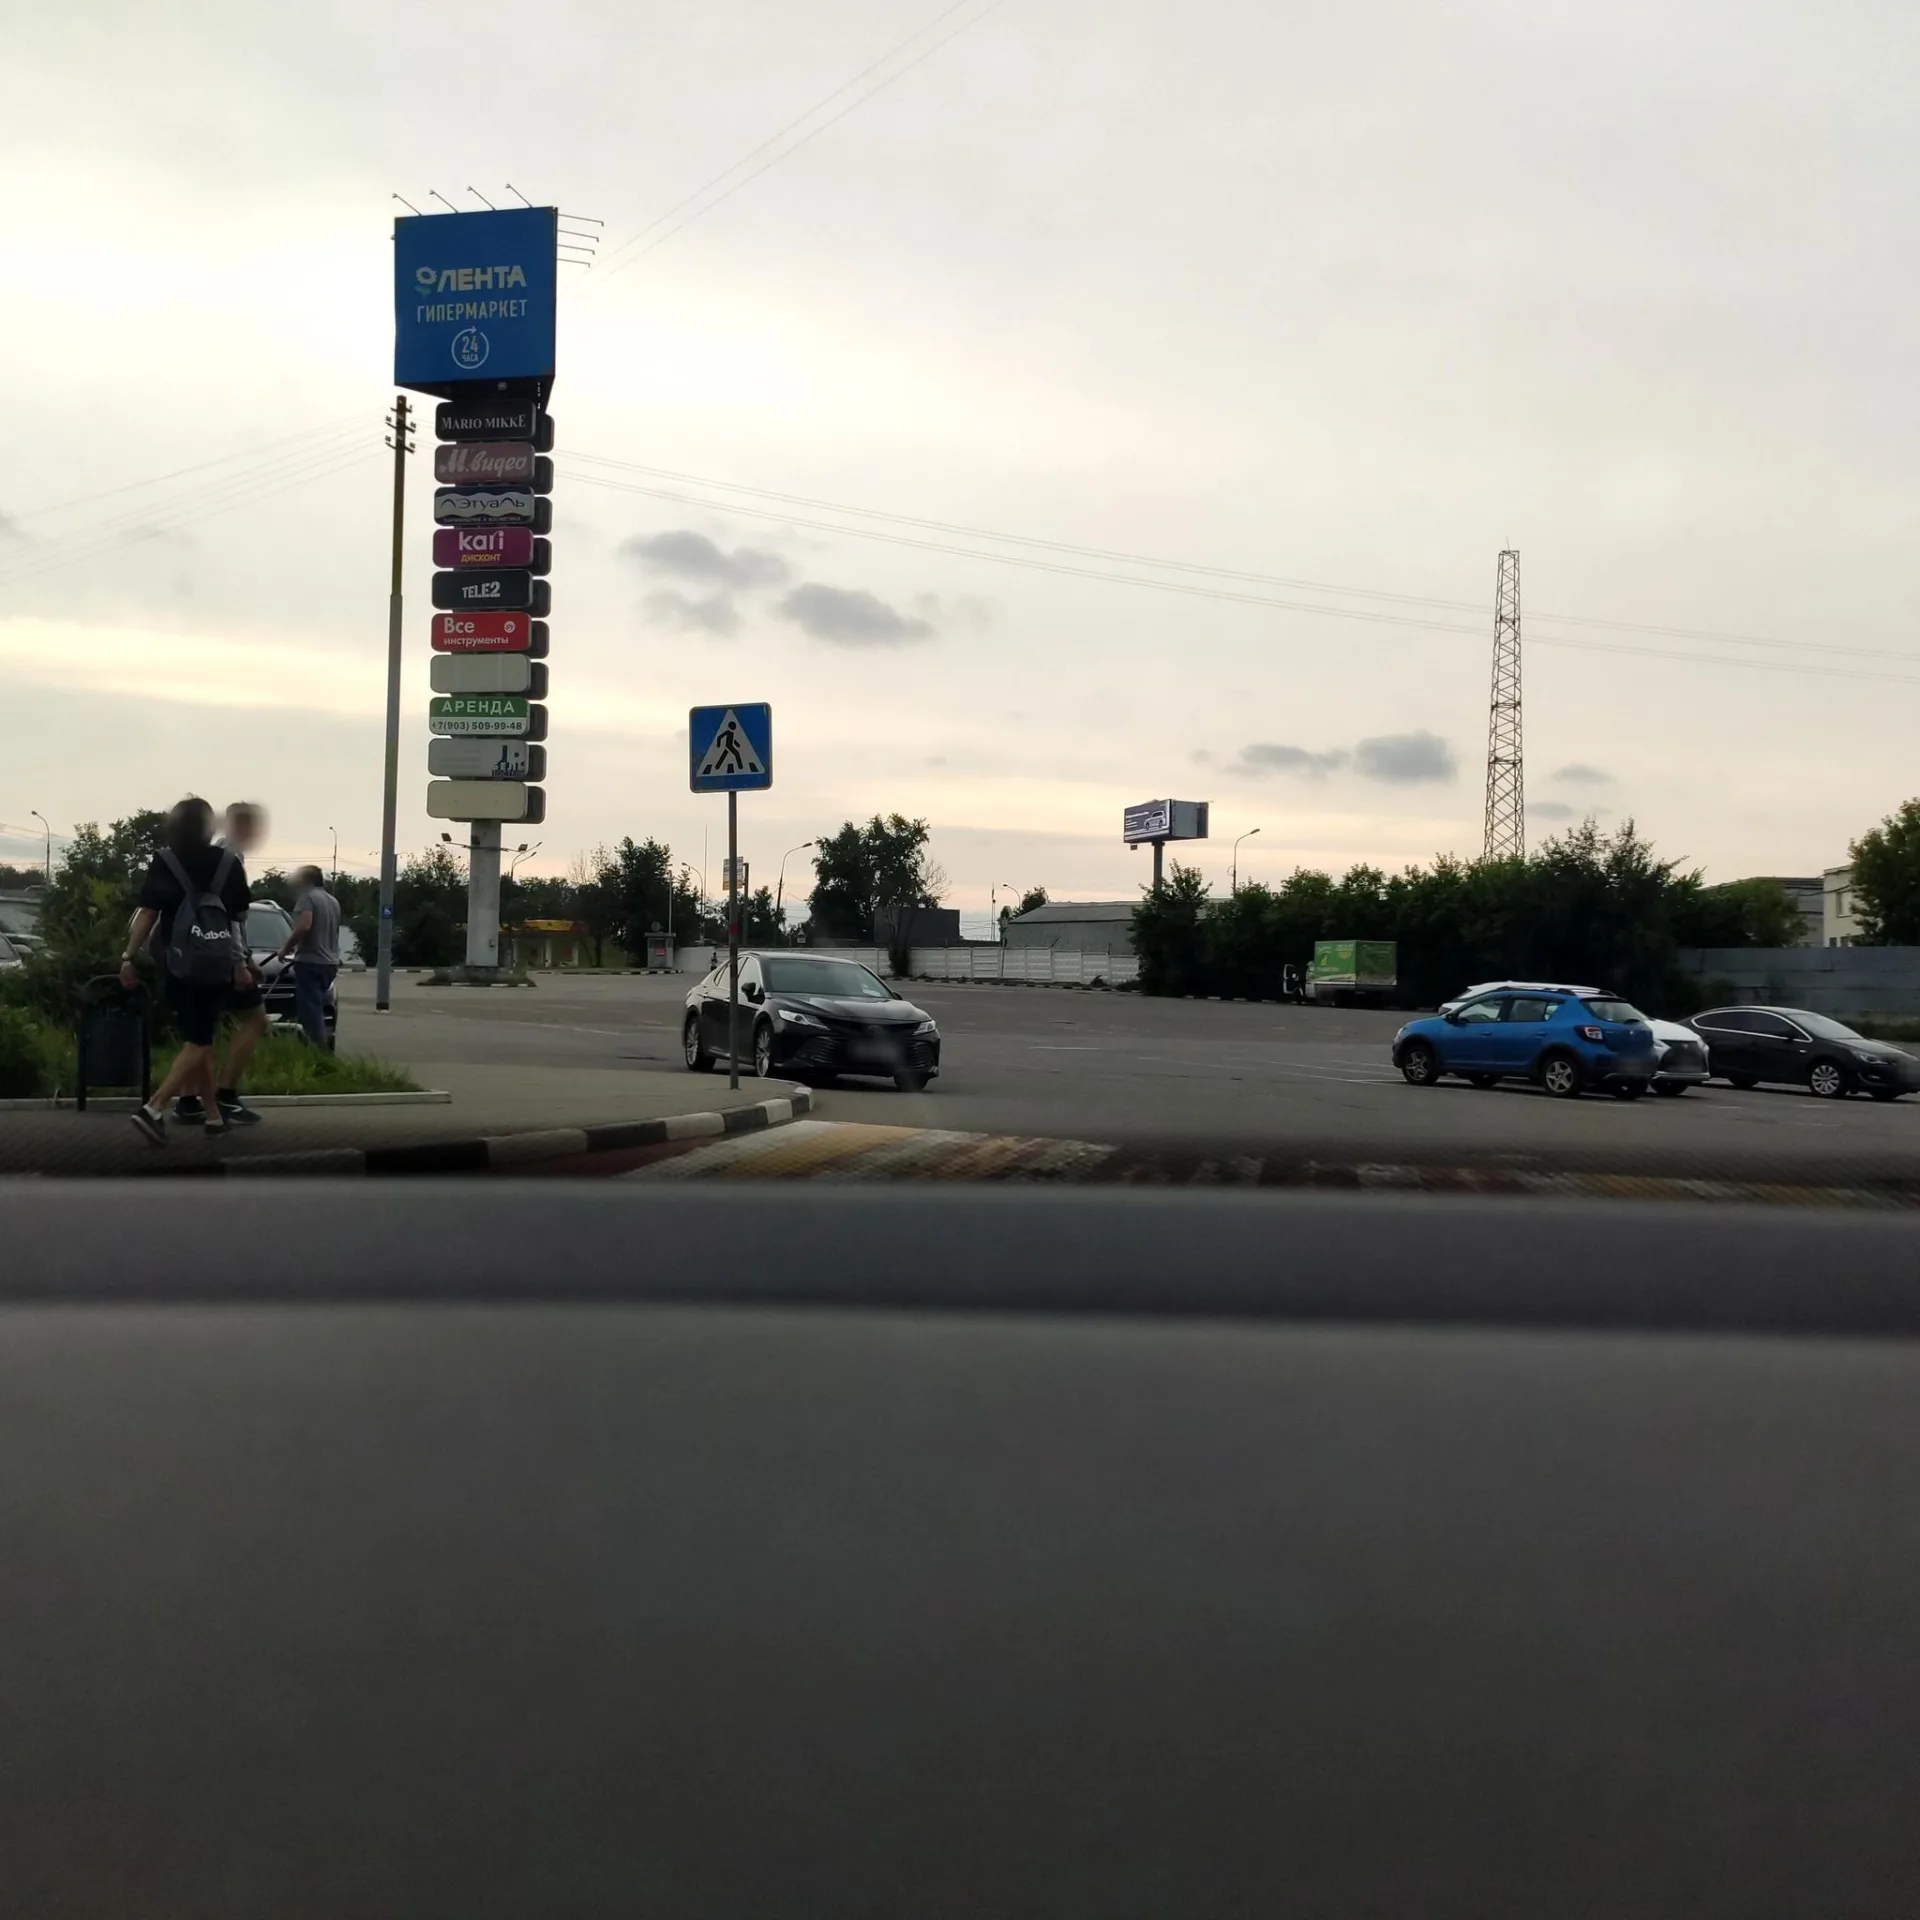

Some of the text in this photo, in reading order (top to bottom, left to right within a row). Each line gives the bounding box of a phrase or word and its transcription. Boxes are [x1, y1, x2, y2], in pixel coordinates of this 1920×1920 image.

[437, 265, 527, 293] ЛЕНТА
[417, 299, 528, 322] ГИПЕРМАРКЕТ
[462, 336, 479, 354] 24
[462, 353, 479, 363] ЧАСА
[441, 414, 526, 430] MARIO MIKKE
[459, 531, 505, 551] kari
[461, 553, 502, 563] ДИСКОНТ
[462, 581, 501, 599] TELE2
[443, 617, 475, 634] Все
[443, 637, 509, 647] инструменты
[442, 700, 515, 715] АРЕНДА
[432, 718, 523, 732] +7(903) 509-99-48
